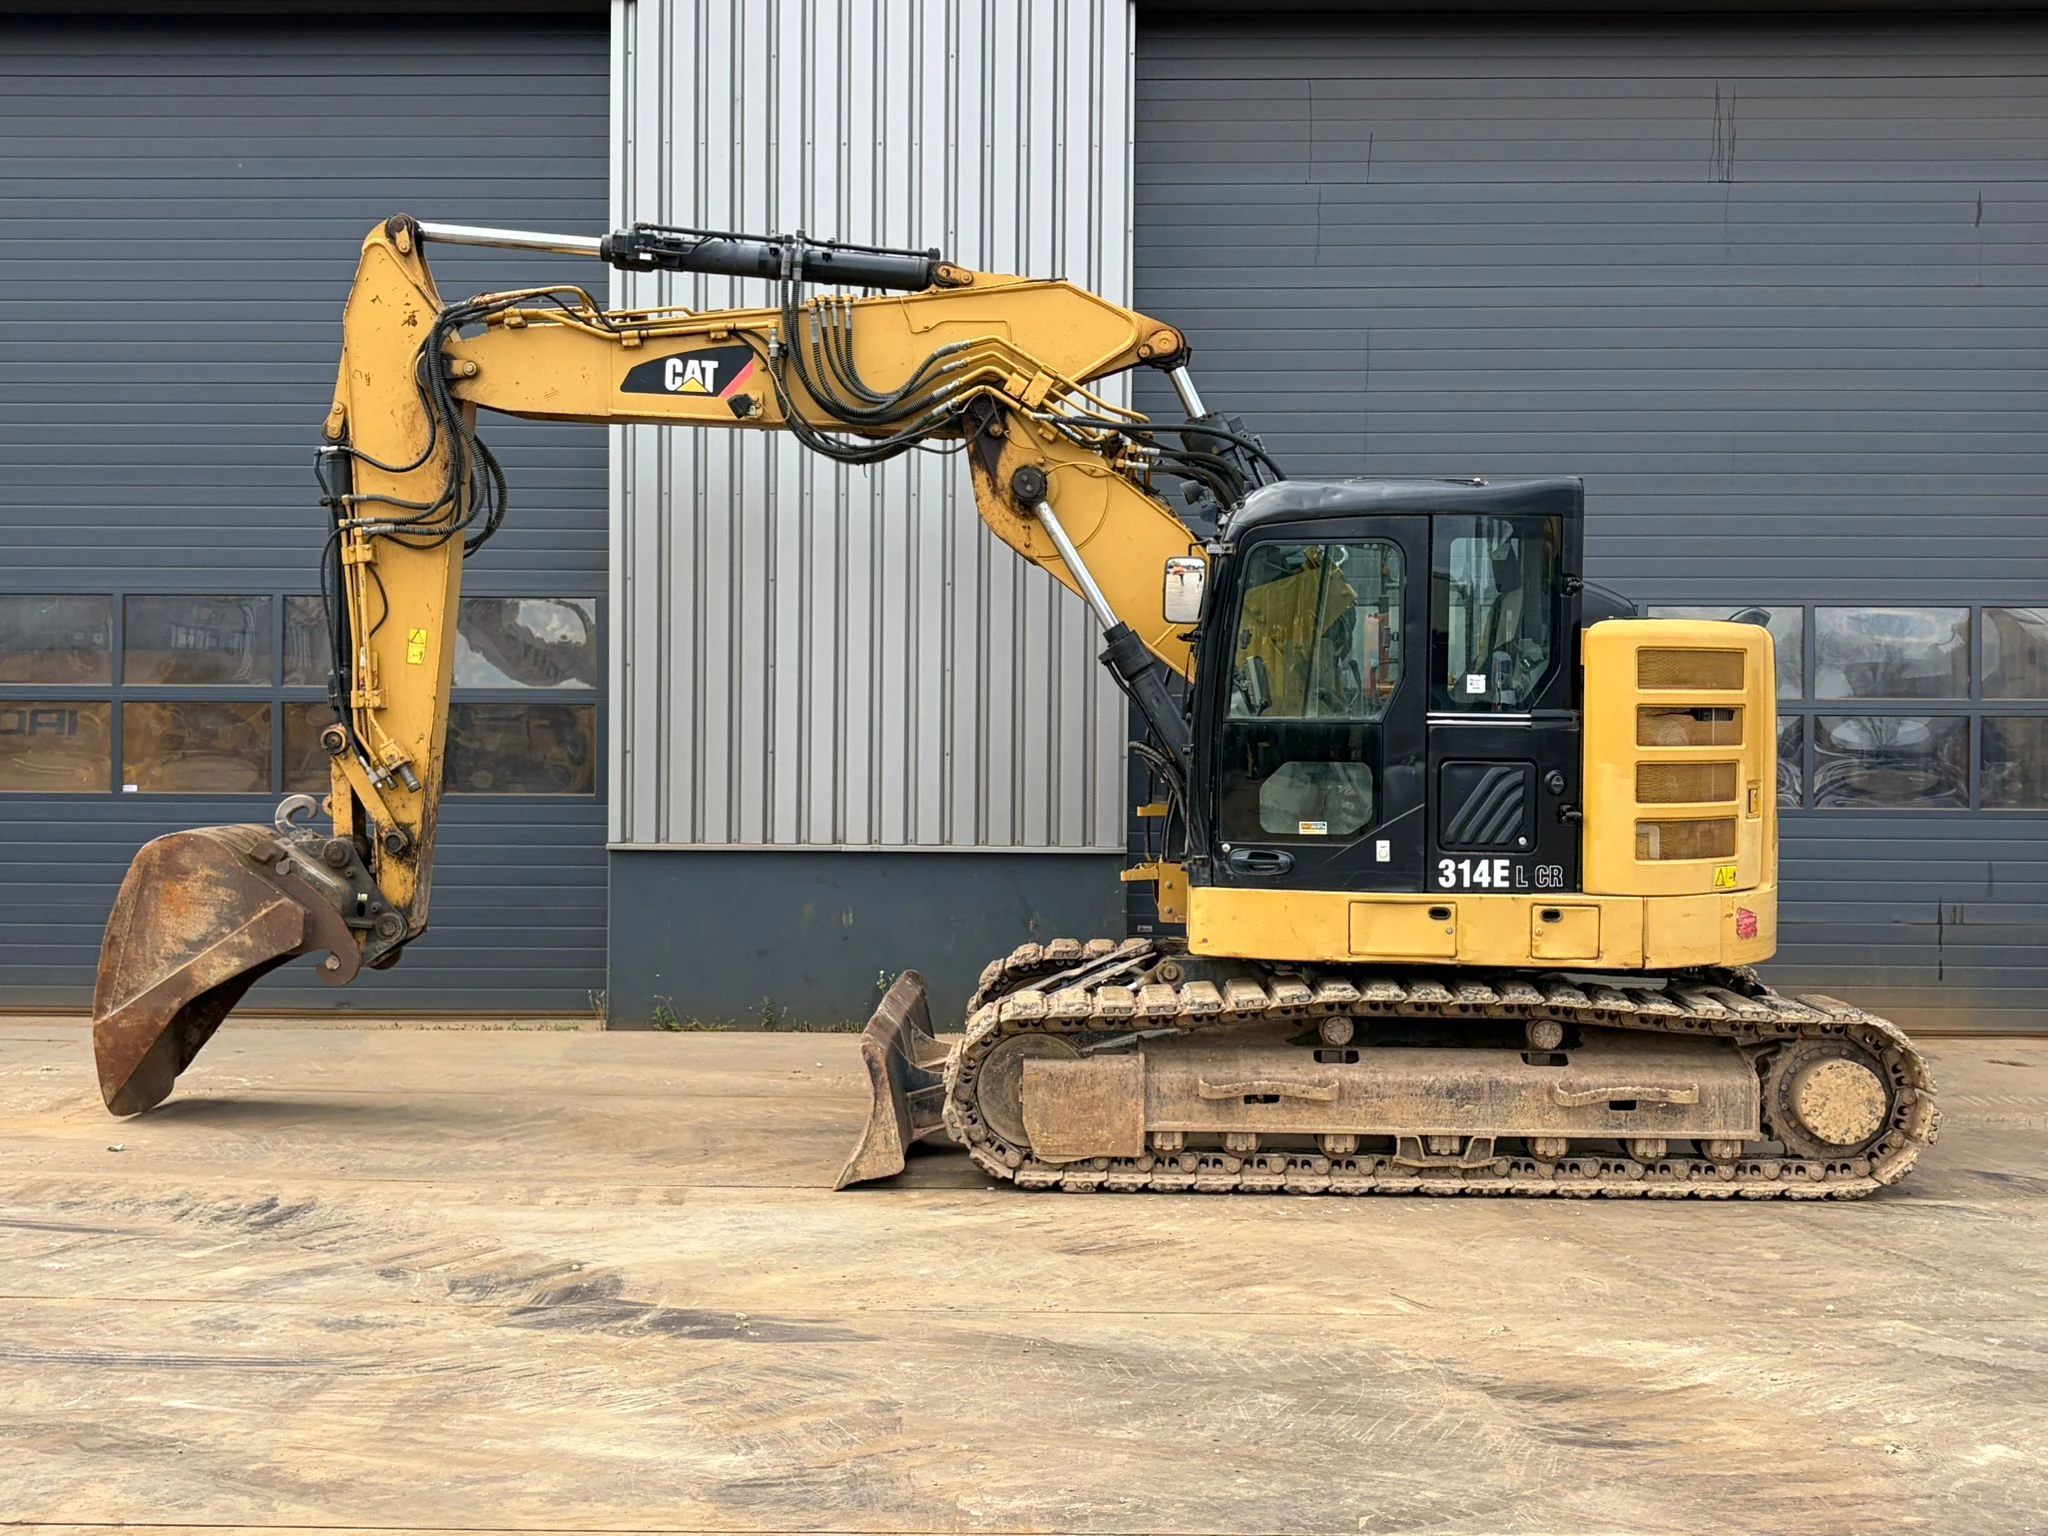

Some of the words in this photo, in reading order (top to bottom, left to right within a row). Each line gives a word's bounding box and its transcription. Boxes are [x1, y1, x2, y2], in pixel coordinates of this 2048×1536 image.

[664, 358, 719, 393] CAT
[1438, 858, 1510, 888] 314E
[1515, 865, 1528, 887] L
[1535, 865, 1563, 888] CR
